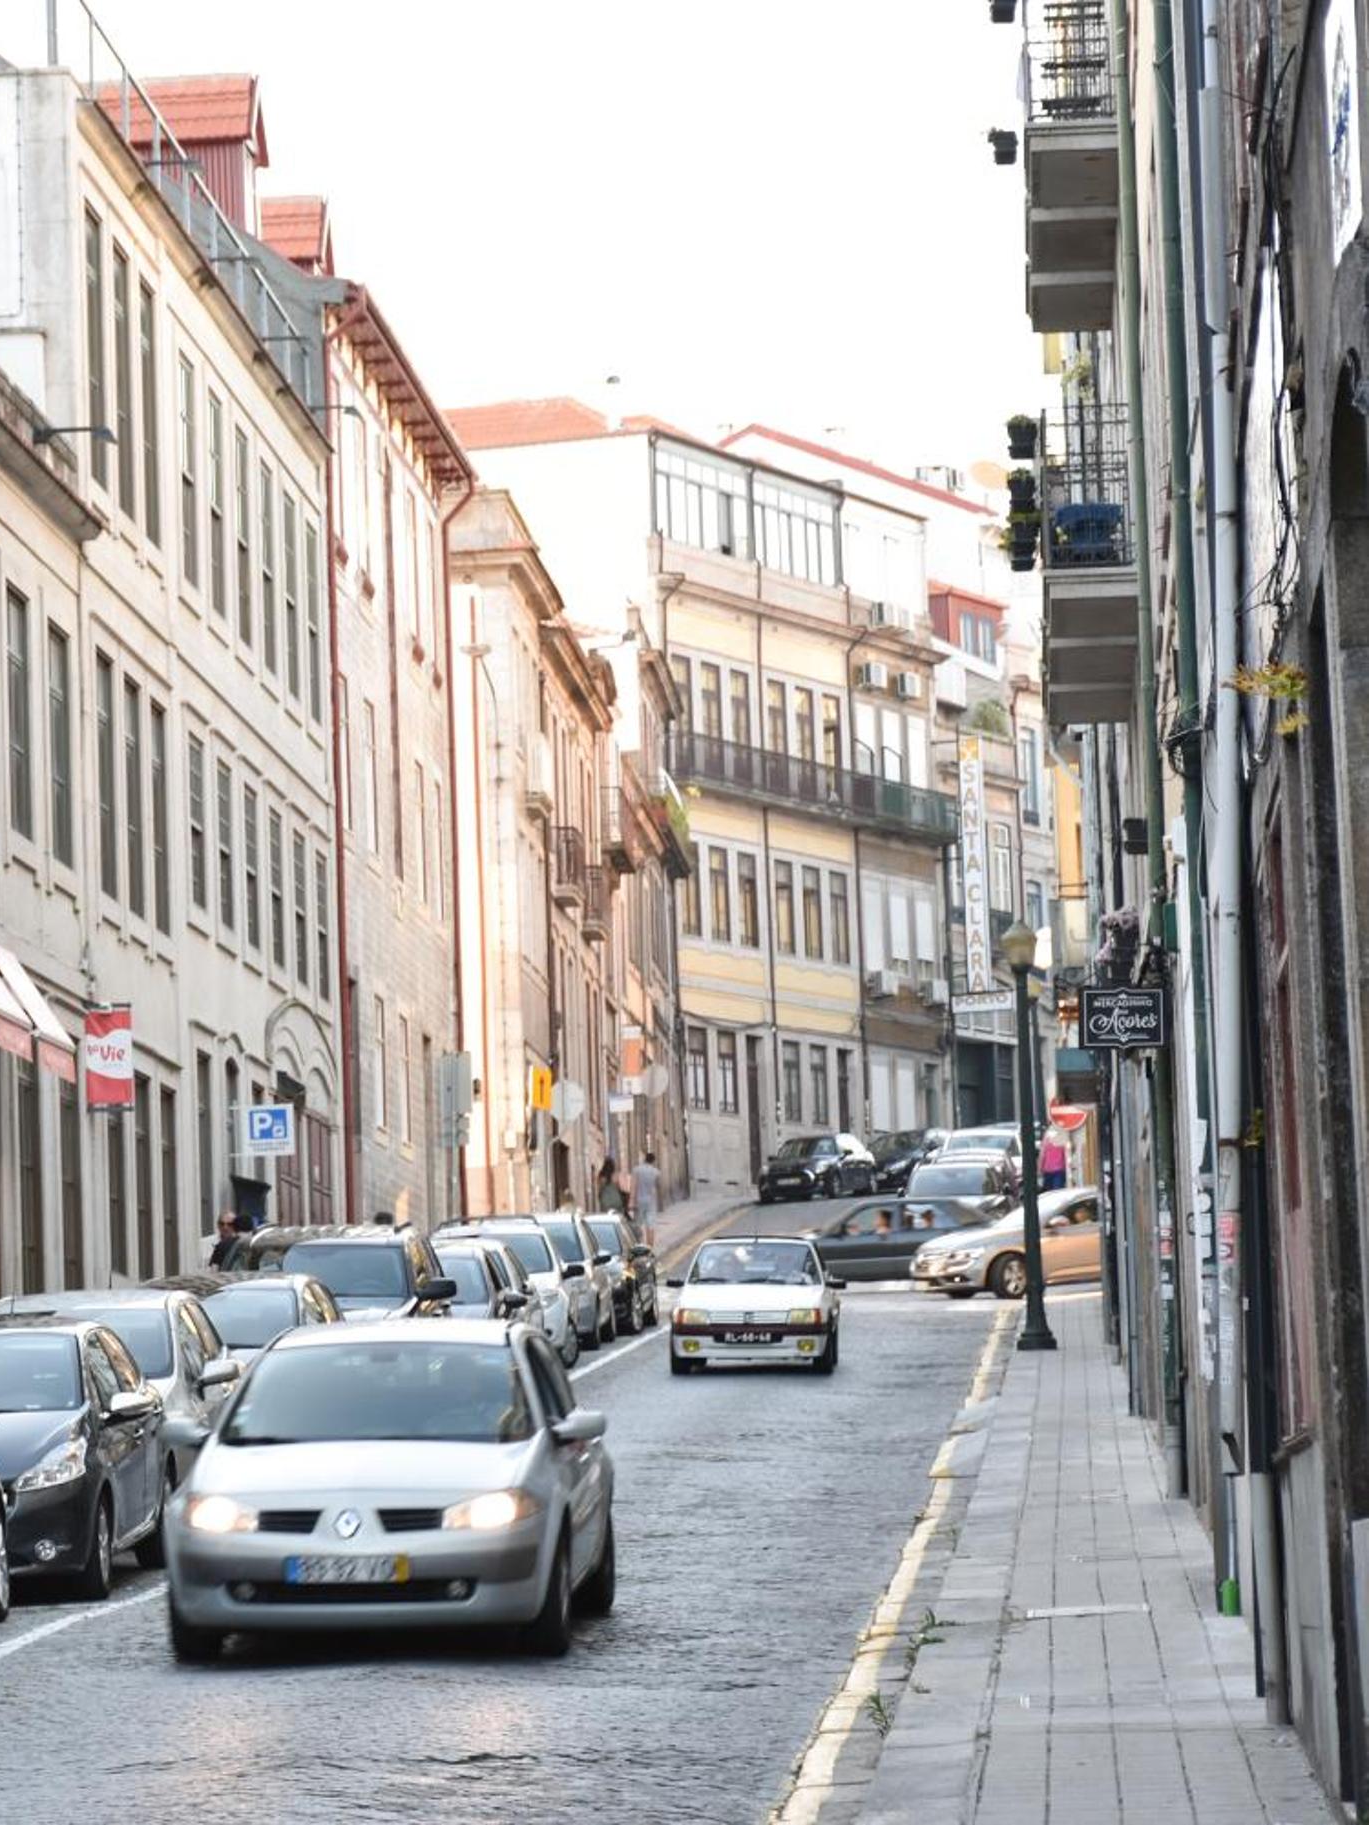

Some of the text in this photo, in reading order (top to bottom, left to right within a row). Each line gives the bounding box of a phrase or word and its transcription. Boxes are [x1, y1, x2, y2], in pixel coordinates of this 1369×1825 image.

[963, 764, 987, 994] SANTA CLARA
[253, 1112, 273, 1139] P
